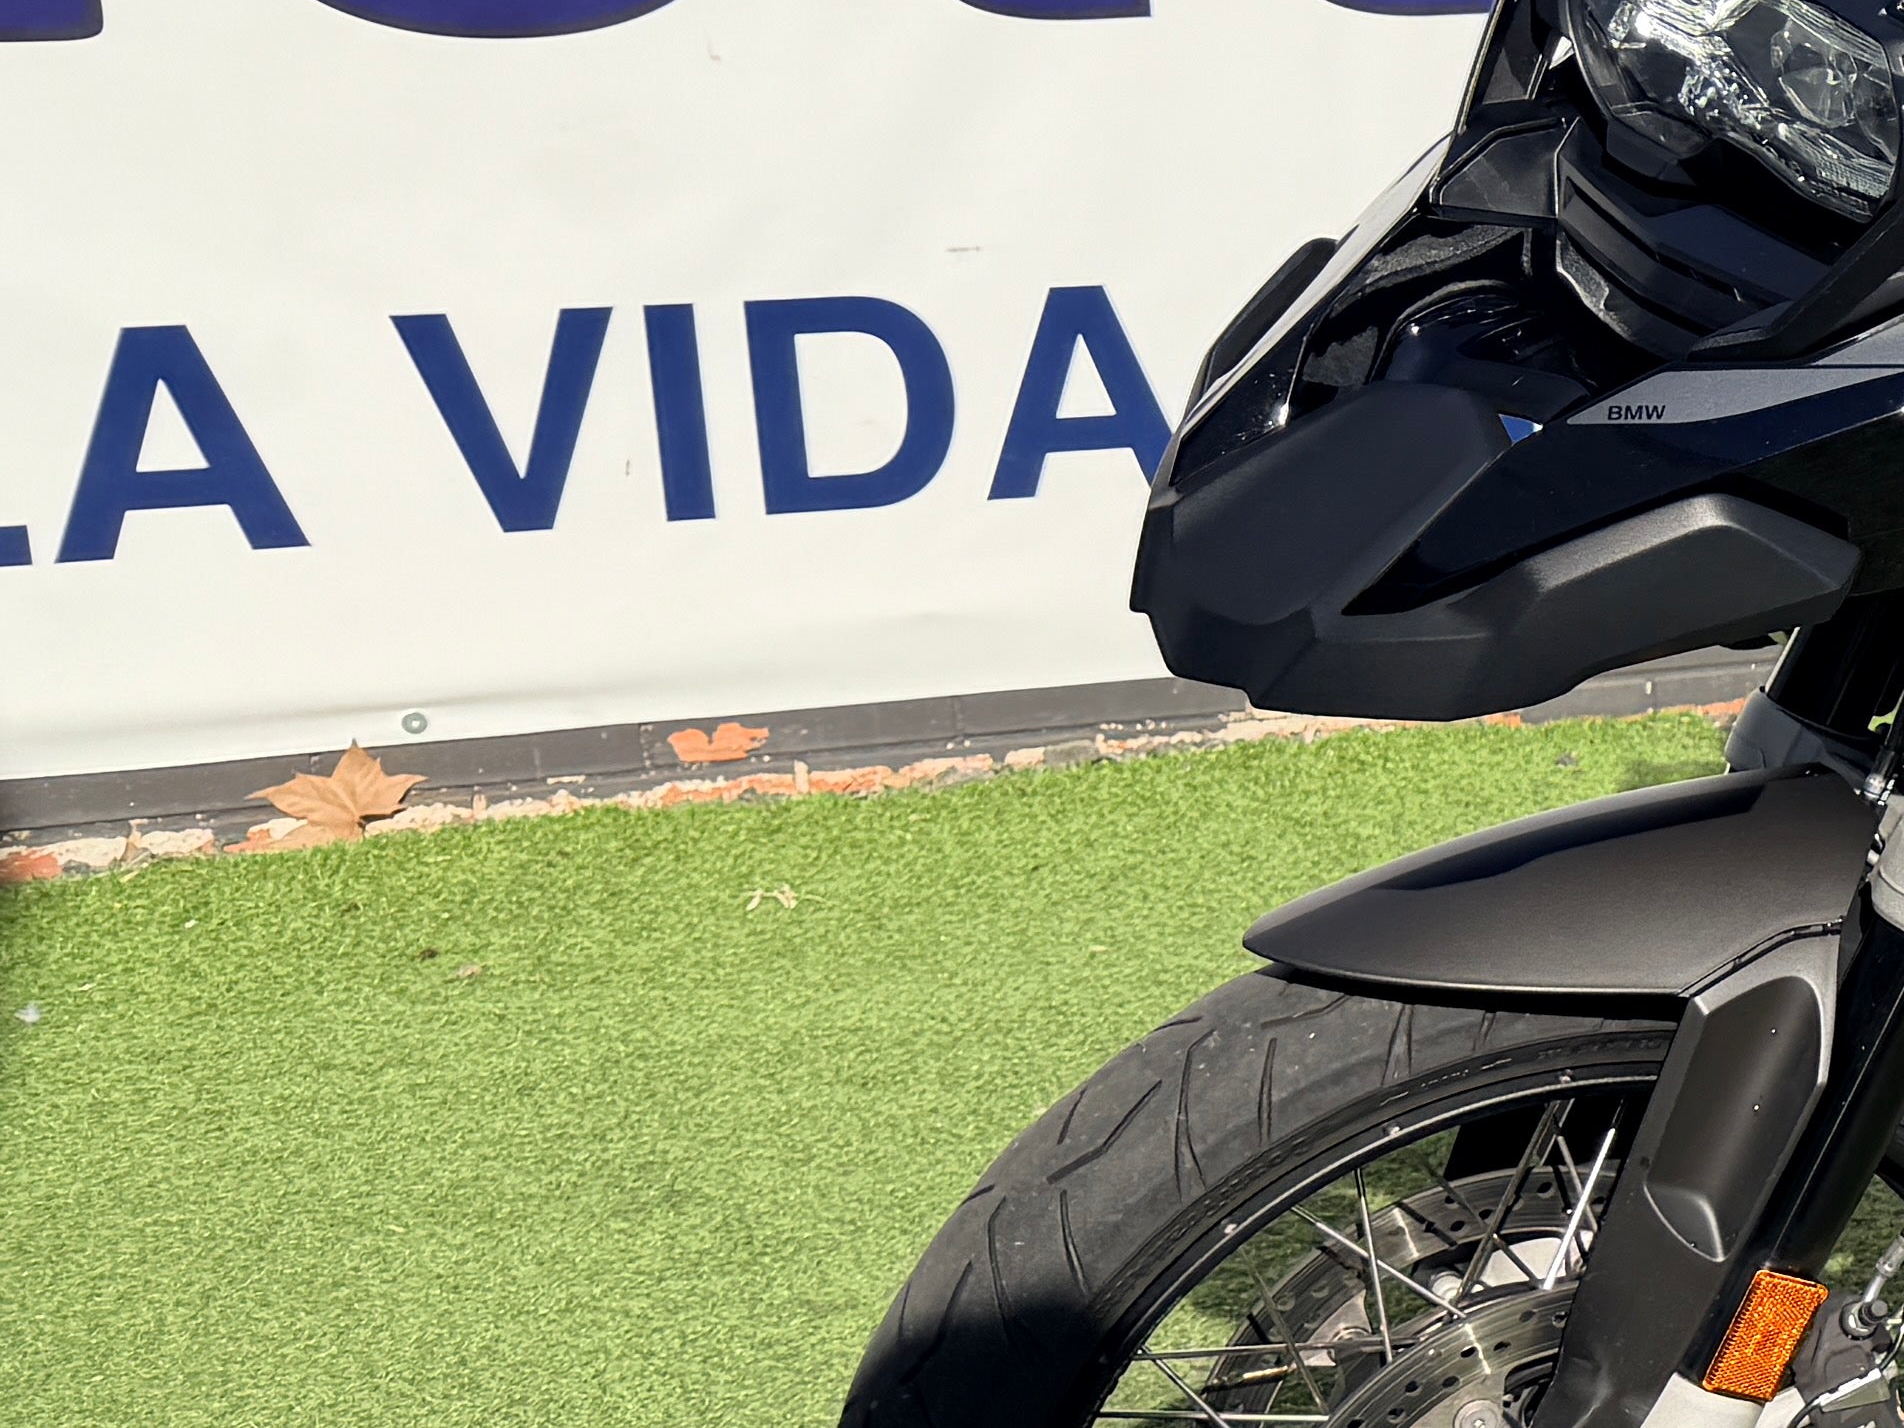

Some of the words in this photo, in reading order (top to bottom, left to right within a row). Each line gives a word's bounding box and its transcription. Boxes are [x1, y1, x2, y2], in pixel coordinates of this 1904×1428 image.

[0, 323, 313, 569] A
[387, 284, 1180, 534] VIDA
[1607, 404, 1667, 421] BMW
